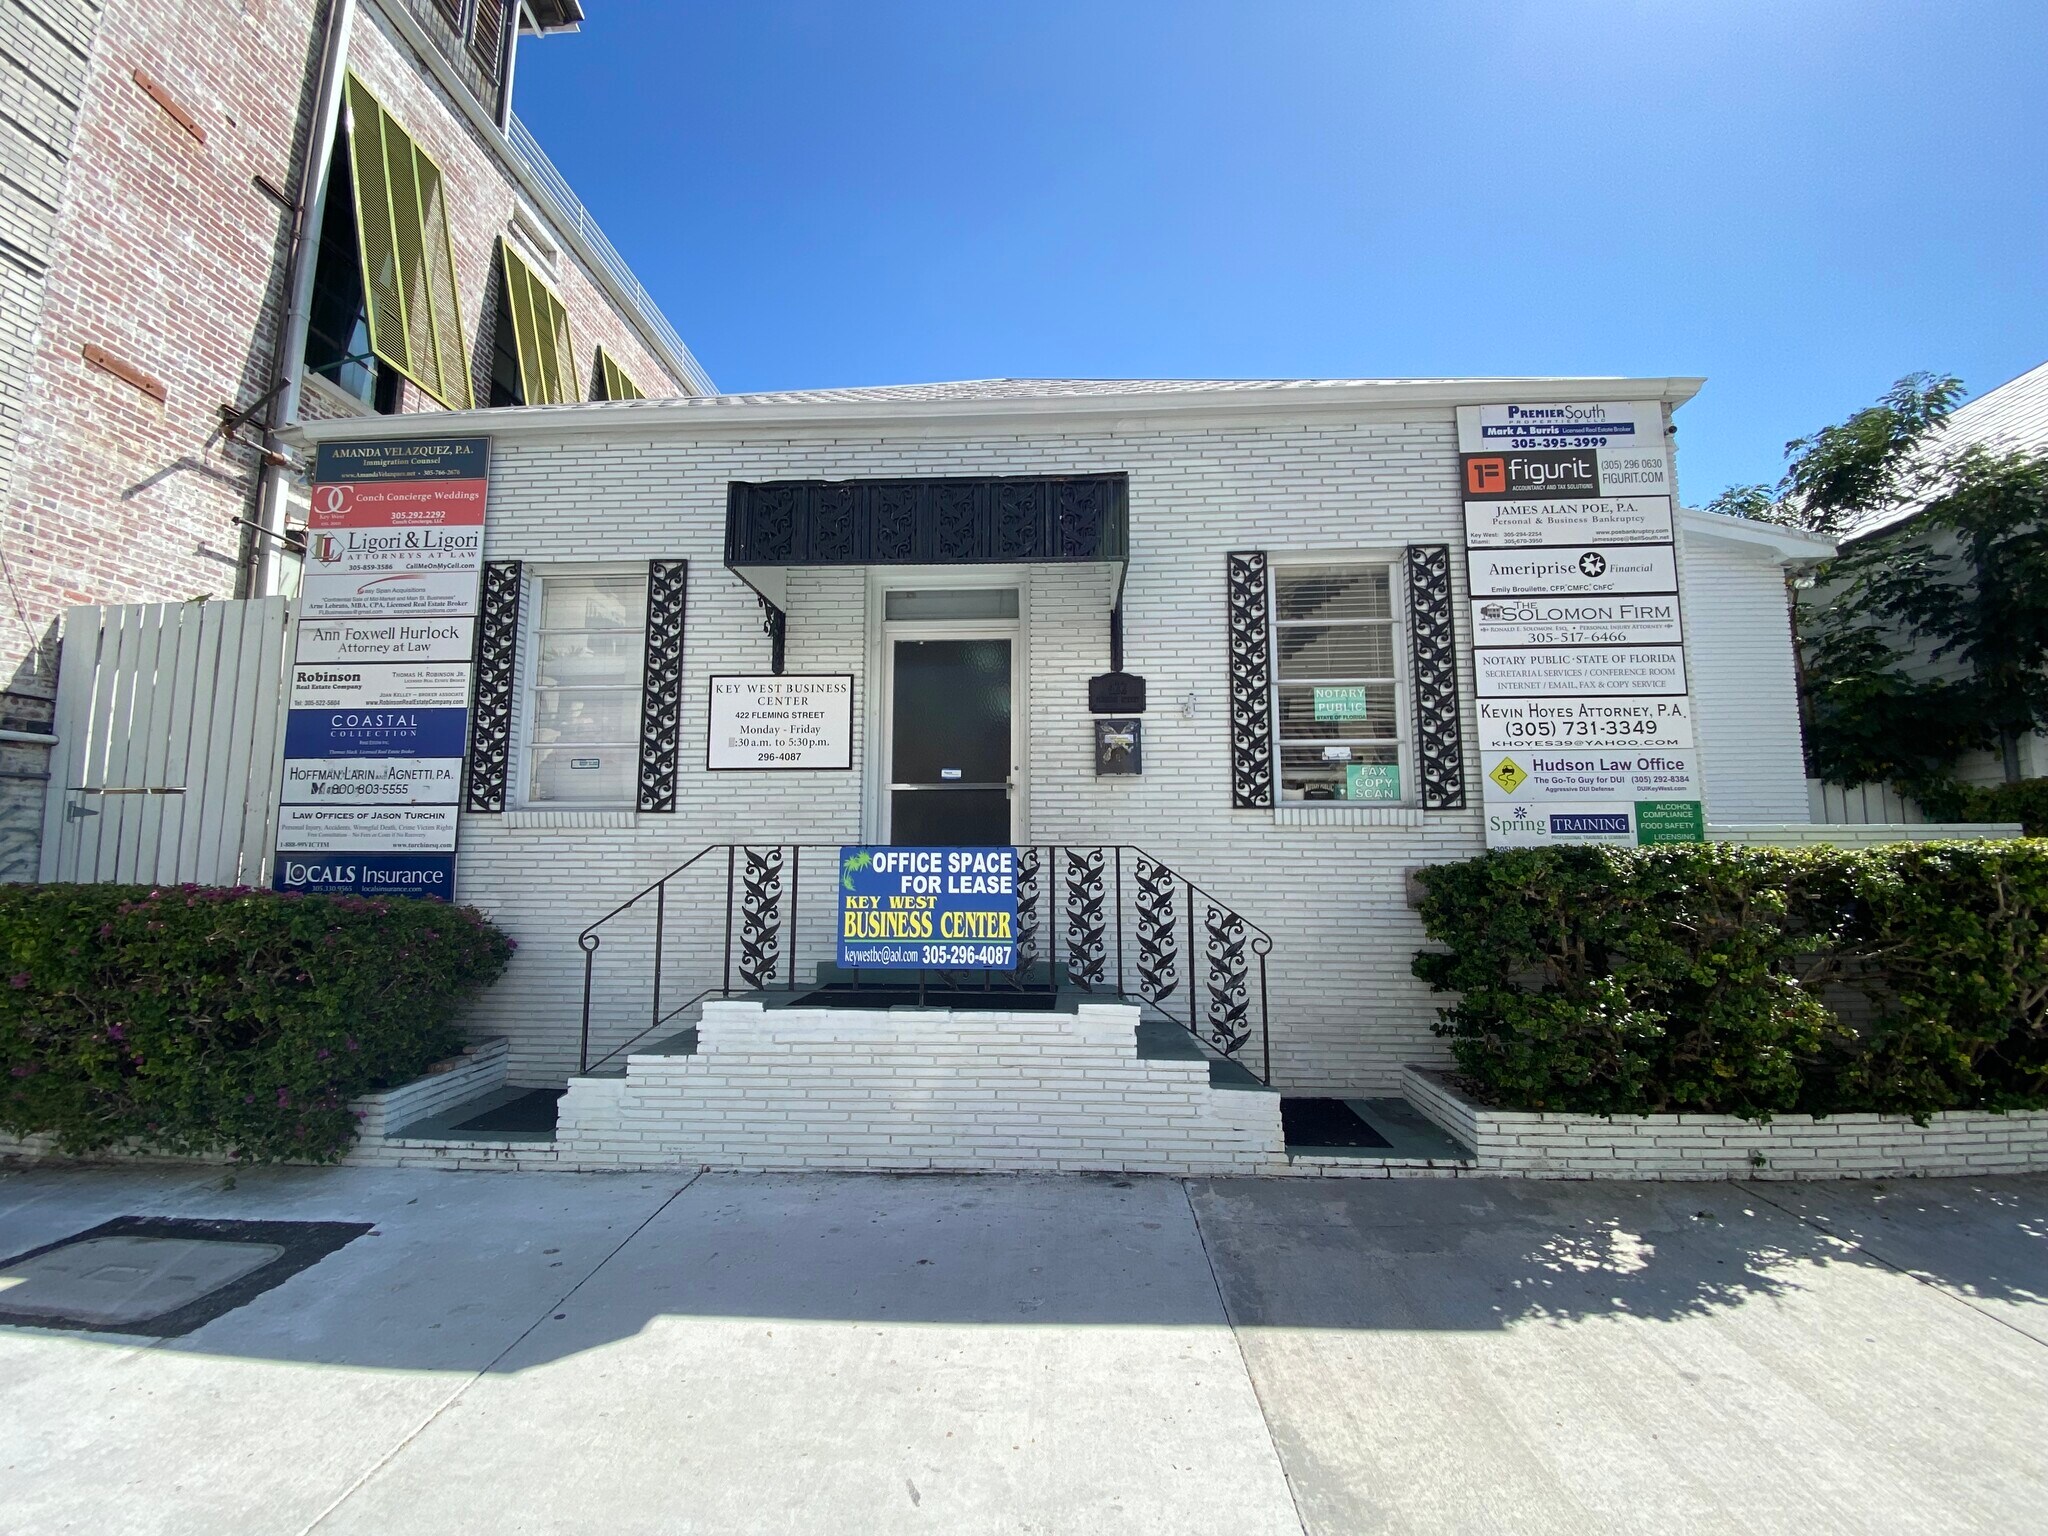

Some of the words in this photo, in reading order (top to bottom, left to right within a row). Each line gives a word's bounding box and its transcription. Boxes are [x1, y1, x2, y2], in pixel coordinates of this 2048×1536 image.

[1530, 426, 1559, 434] Burris
[1512, 438, 1607, 448] 305-395-3999
[332, 449, 380, 458] AMANDA
[385, 446, 452, 456] VELAZQUEZ,
[455, 446, 473, 454] P.A.
[363, 459, 409, 467] Immigration
[1601, 460, 1622, 470] (305)
[1624, 460, 1640, 468] 296
[1642, 459, 1662, 468] 0630
[1509, 457, 1592, 484] figurit
[1602, 472, 1663, 483] FIGURIT.COM
[356, 494, 384, 502] Conch
[387, 492, 431, 502] Concierge
[435, 492, 479, 500] Weddings
[391, 511, 445, 519] 305.292.2292
[1496, 505, 1537, 517] JAMES
[1541, 505, 1578, 514] ALAN
[1582, 504, 1613, 514] POE,
[1616, 503, 1638, 512] P.A.
[1492, 517, 1532, 525] Personal
[1548, 516, 1588, 524] Business
[1592, 516, 1645, 524] Bankruptcy
[348, 531, 401, 553] Ligori
[405, 532, 419, 548] &
[424, 530, 478, 551] Ligori
[1489, 562, 1576, 578] Ameriprise
[1610, 564, 1653, 573] Financial
[1514, 601, 1537, 609] THE
[1502, 607, 1611, 621] SOLOMON
[1620, 605, 1670, 619] FIRM
[313, 628, 340, 641] Ann
[345, 627, 395, 640] Foxwell
[400, 626, 459, 639] Hurlock
[1528, 632, 1626, 643] 305-517-6466
[338, 643, 392, 654] Attorney
[393, 643, 404, 651] at
[408, 643, 431, 651] Law
[1483, 657, 1527, 665] NOTARY
[1530, 656, 1570, 664] PUBLIC
[1576, 655, 1607, 663] STATE
[1612, 655, 1625, 663] OF
[1629, 654, 1676, 663] FLORIDA
[297, 672, 361, 682] Robinson
[1486, 670, 1542, 678] SECRETARIAL
[716, 685, 741, 693] KEY
[748, 684, 782, 693] WEST
[786, 684, 846, 693] BUSINESS
[1548, 681, 1577, 689] EMAIL,
[1316, 689, 1365, 698] NOTARY
[758, 697, 808, 705] CENTER
[1318, 703, 1362, 712] PUBLIC
[1481, 704, 1523, 718] KEVIN
[1529, 703, 1573, 718] HOYES
[1579, 704, 1652, 718] ATTORNEY,
[1658, 704, 1687, 718] P.A.
[332, 715, 418, 727] COASTAL
[740, 725, 780, 736] Monday
[790, 725, 821, 735] Friday
[1506, 722, 1556, 737] (305)
[1563, 721, 1657, 736] 731-3349
[758, 753, 801, 761] 296-4087
[1533, 759, 1594, 771] Hudson
[1600, 759, 1632, 771] Law
[1637, 758, 1684, 771] Office
[1362, 768, 1386, 776] FAX
[1356, 779, 1392, 787] COPY
[1578, 777, 1594, 785] Guy
[1631, 776, 1651, 784] (305)
[1356, 790, 1393, 798] SCAN
[293, 812, 312, 820] LAW
[315, 812, 354, 820] OFFICES
[1490, 816, 1546, 835] Spring
[1553, 818, 1627, 830] TRAINING
[872, 852, 942, 873] OFFICE
[948, 852, 1012, 873] SPACE
[283, 862, 355, 886] LOCALS
[362, 866, 443, 883] Insurance
[901, 876, 942, 893] FOR
[948, 876, 1012, 893] LEASE
[846, 896, 881, 909] KEY
[889, 896, 938, 909] WEST
[844, 911, 933, 938] BUSINESS
[940, 912, 1011, 938] CENTER
[845, 946, 918, 965] keywestbc@aol.com
[922, 946, 1011, 964] 305-296-4087
